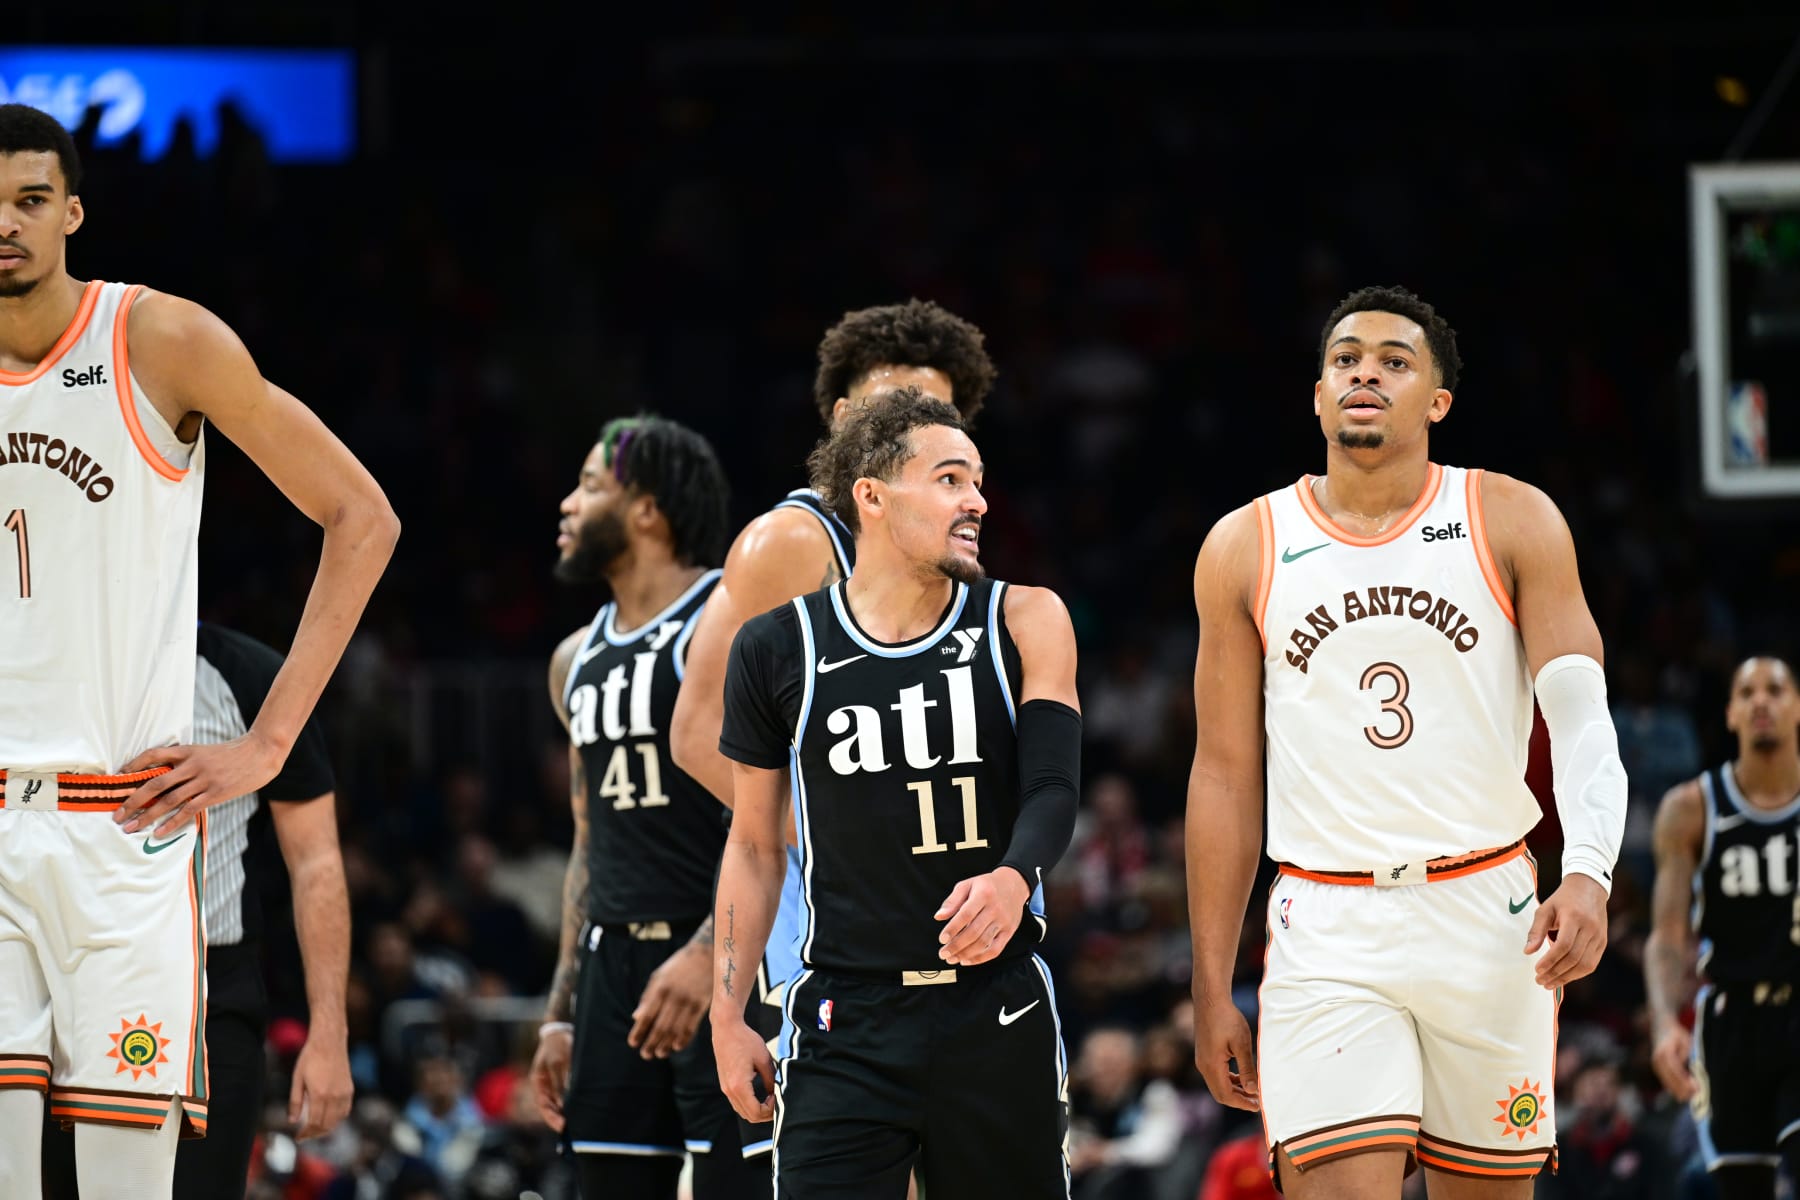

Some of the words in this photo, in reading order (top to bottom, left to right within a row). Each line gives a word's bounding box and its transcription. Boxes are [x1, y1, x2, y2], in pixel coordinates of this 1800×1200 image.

[62, 364, 107, 388] Self.
[0, 432, 114, 503] NTONIO
[4, 508, 31, 599] 1
[1421, 522, 1467, 543] Self.
[941, 646, 957, 655] the
[1285, 604, 1339, 675] SAN
[1343, 586, 1479, 653] ANTONIO
[569, 651, 658, 748] atl
[826, 665, 983, 776] atl
[1359, 661, 1414, 750] 3
[599, 742, 670, 811] 41
[906, 776, 988, 855] 11
[1720, 826, 1800, 897] at
